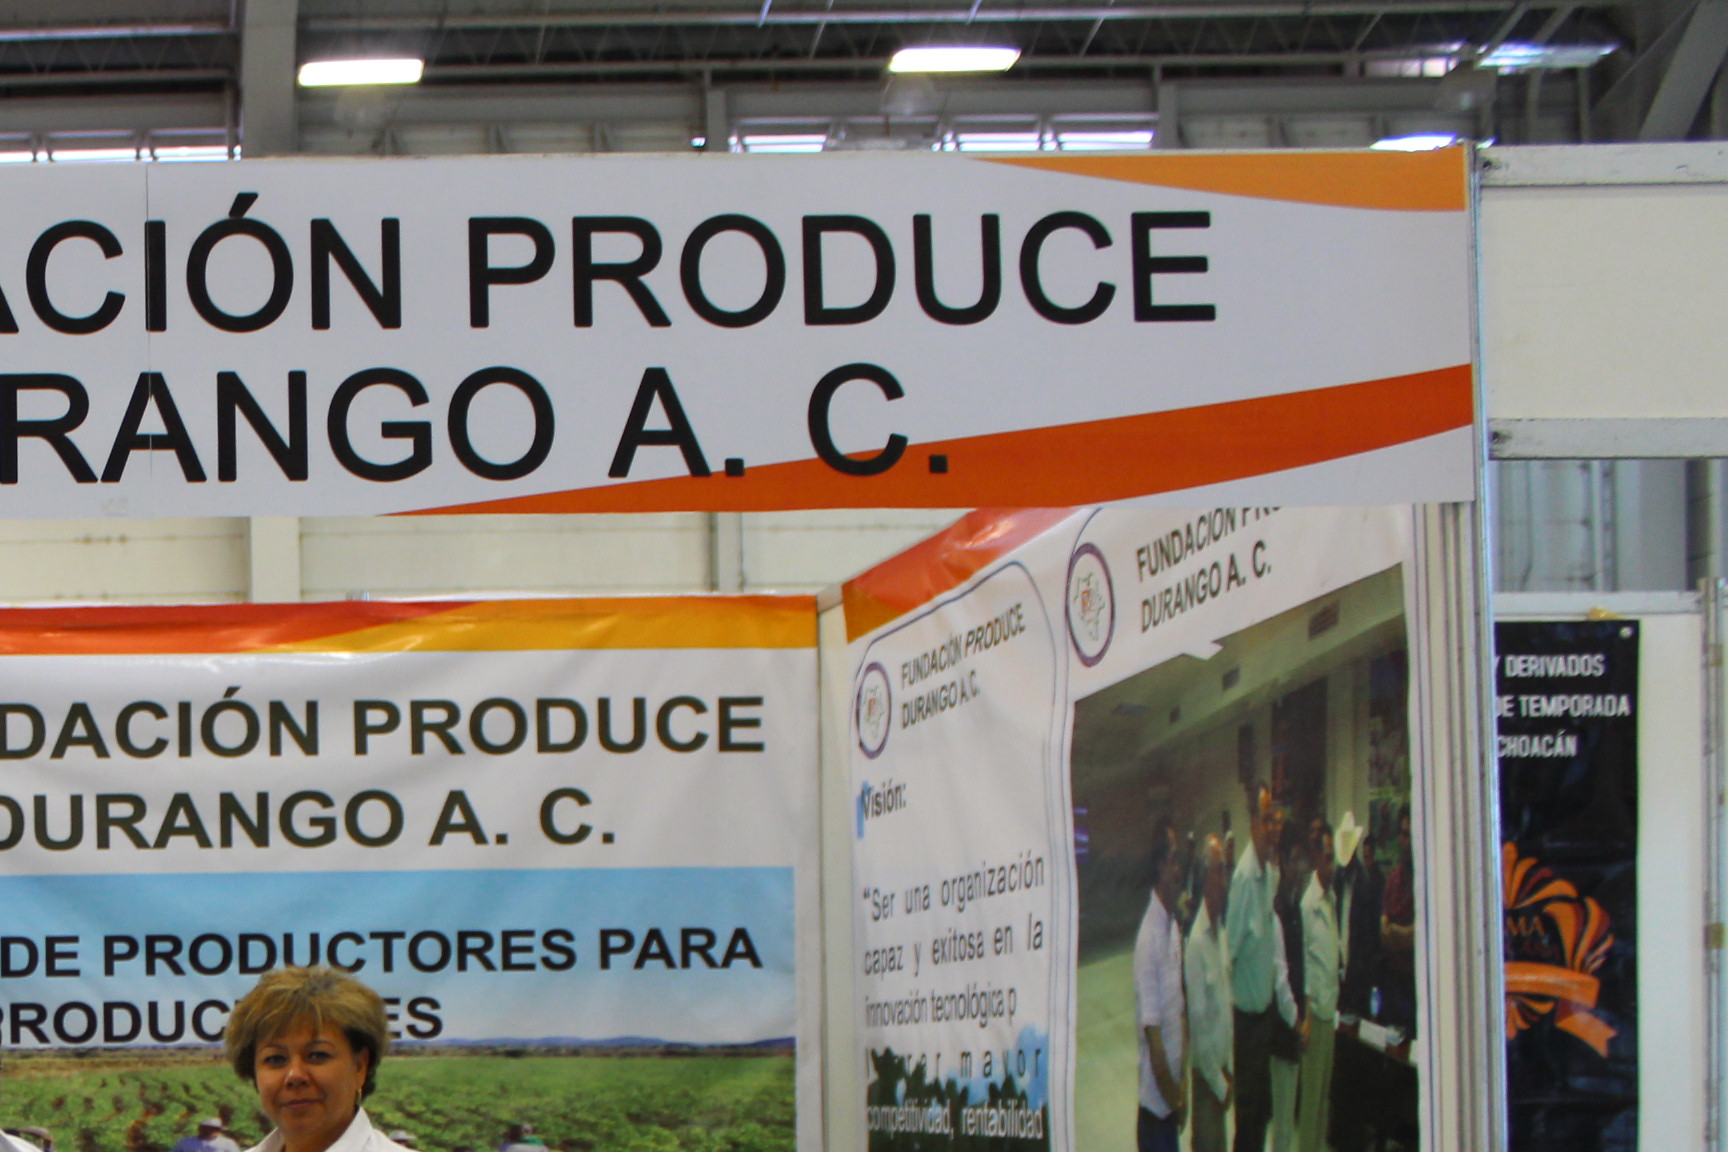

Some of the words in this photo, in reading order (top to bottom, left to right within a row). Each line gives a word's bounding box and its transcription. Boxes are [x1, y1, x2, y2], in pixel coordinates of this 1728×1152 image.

[468, 210, 1216, 329] PRODUCE
[607, 366, 745, 478] A.
[807, 363, 948, 476] C.
[1142, 560, 1222, 633] DURANGO
[1226, 553, 1246, 592] A.
[1252, 540, 1272, 579] C.
[901, 632, 962, 690] FUNDACIÓN
[965, 603, 1026, 657] PRODUCE
[1505, 654, 1606, 678] DERIVADOS
[353, 695, 766, 758] PRODUCE
[902, 681, 957, 729] DURANGO
[1518, 694, 1632, 718] TEMPORADA
[428, 789, 509, 847] A.
[539, 787, 614, 846] C.
[861, 778, 907, 820] Visión:
[905, 884, 930, 914] una
[942, 851, 1044, 912] organización
[0, 934, 81, 979] DE
[104, 928, 577, 977] PRODUCTORES
[599, 927, 763, 971] PARA
[864, 945, 903, 979] capaz
[914, 942, 921, 977] y
[932, 928, 985, 966] exitosa
[994, 925, 1013, 955] en
[1028, 913, 1043, 950] la
[865, 990, 927, 1029] innovación
[932, 982, 1004, 1029] tecnológica
[960, 1048, 1041, 1079] mayor
[962, 1101, 1044, 1139] rentabilidad
